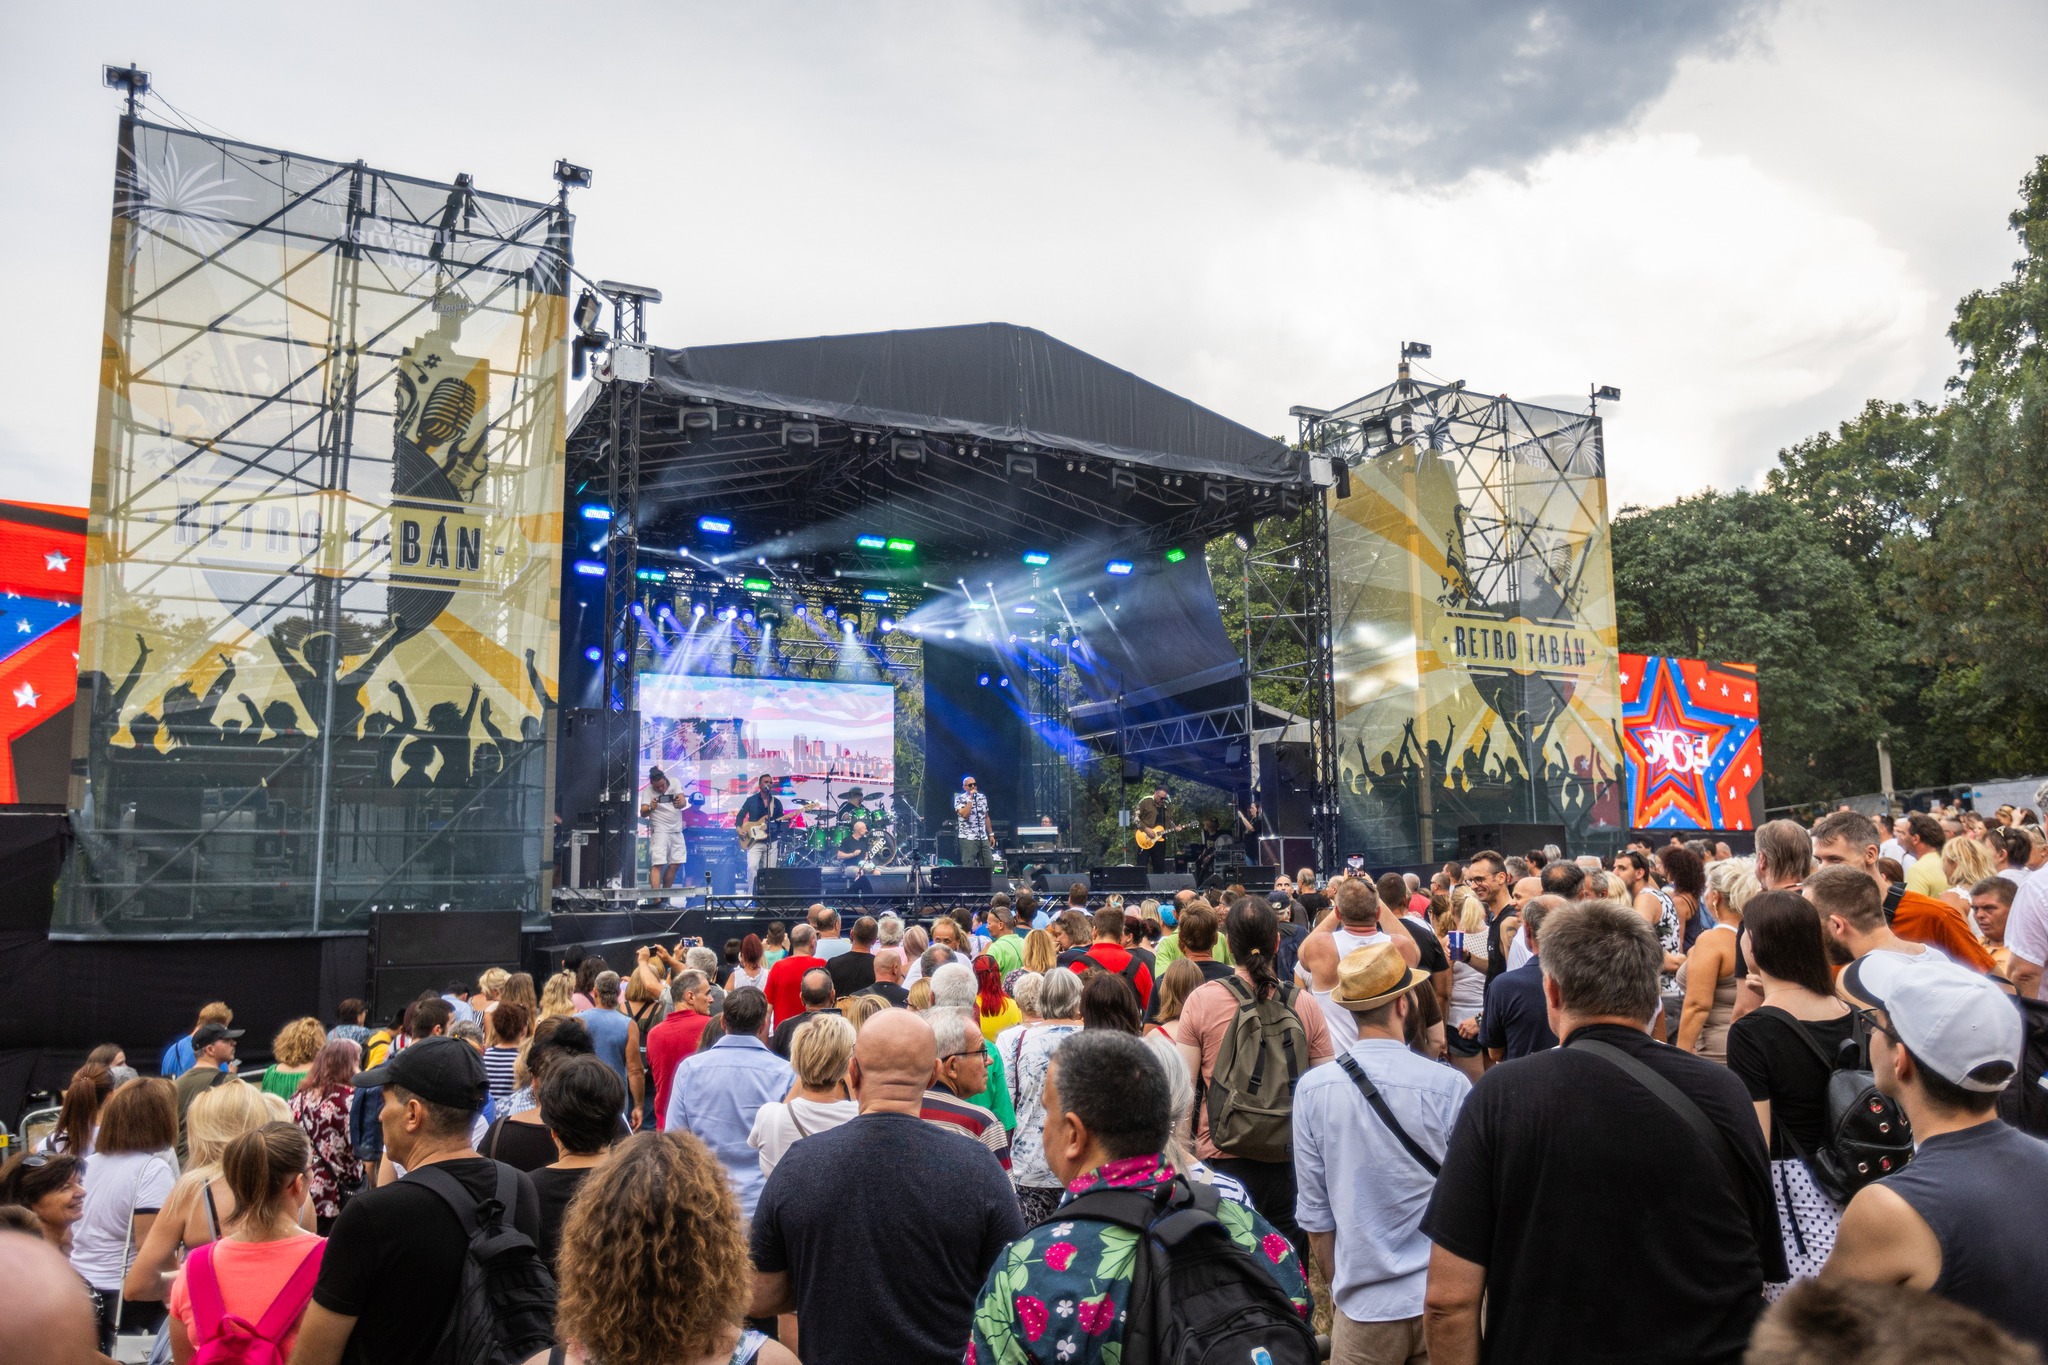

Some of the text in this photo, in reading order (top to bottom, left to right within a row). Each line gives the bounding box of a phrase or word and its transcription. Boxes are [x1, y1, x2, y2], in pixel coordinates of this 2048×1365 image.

[174, 496, 482, 573] RETRO TABÁN
[1454, 625, 1586, 667] RETRO TABÁN
